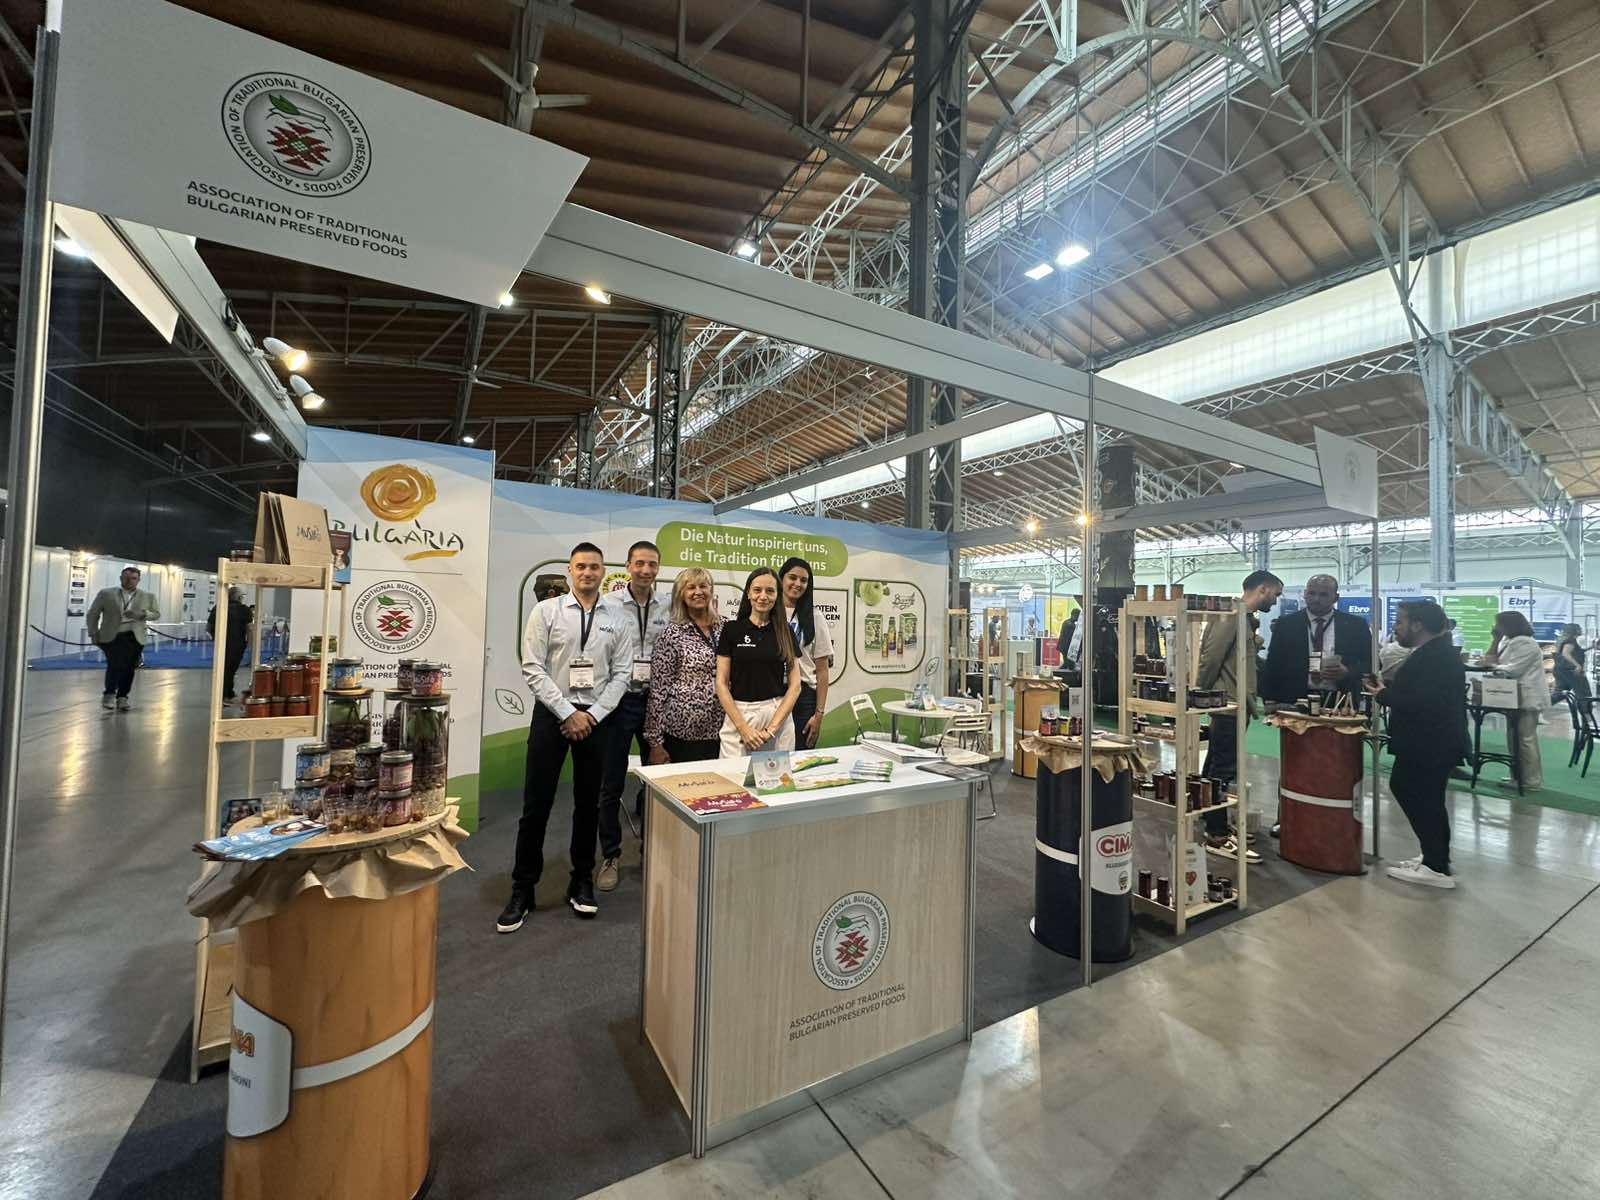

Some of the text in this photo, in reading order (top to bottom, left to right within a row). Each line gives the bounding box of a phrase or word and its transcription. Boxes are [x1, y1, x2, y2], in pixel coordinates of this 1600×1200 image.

[229, 77, 366, 193] ASSOCIATION OF TRADITIONAL BULGARIAN PRESERVED FOODS
[187, 180, 408, 246] ASSOCIATION OF TRADITIONAL
[187, 194, 408, 259] BULGARIAN PRESERVED FOODS
[680, 528, 828, 555] Die Natur inspiriert uns,
[680, 547, 702, 562] die
[705, 550, 767, 567] Tradition
[356, 584, 433, 650] ASSOCIATION OF TRADITIONAL BULGARIAN PRESERVED FOODS
[1509, 597, 1536, 605] Ebro
[817, 898, 851, 941] TRADITIONAL
[853, 896, 884, 917] BULGARIAN
[816, 945, 821, 955] OF
[817, 957, 849, 986] ASSOCIATION
[854, 963, 876, 983] FOODS
[789, 993, 906, 1042] BULGARIAN PRESERVED FOODS
[790, 984, 905, 1029] ASSOCIATION OF TRADITIONAL
